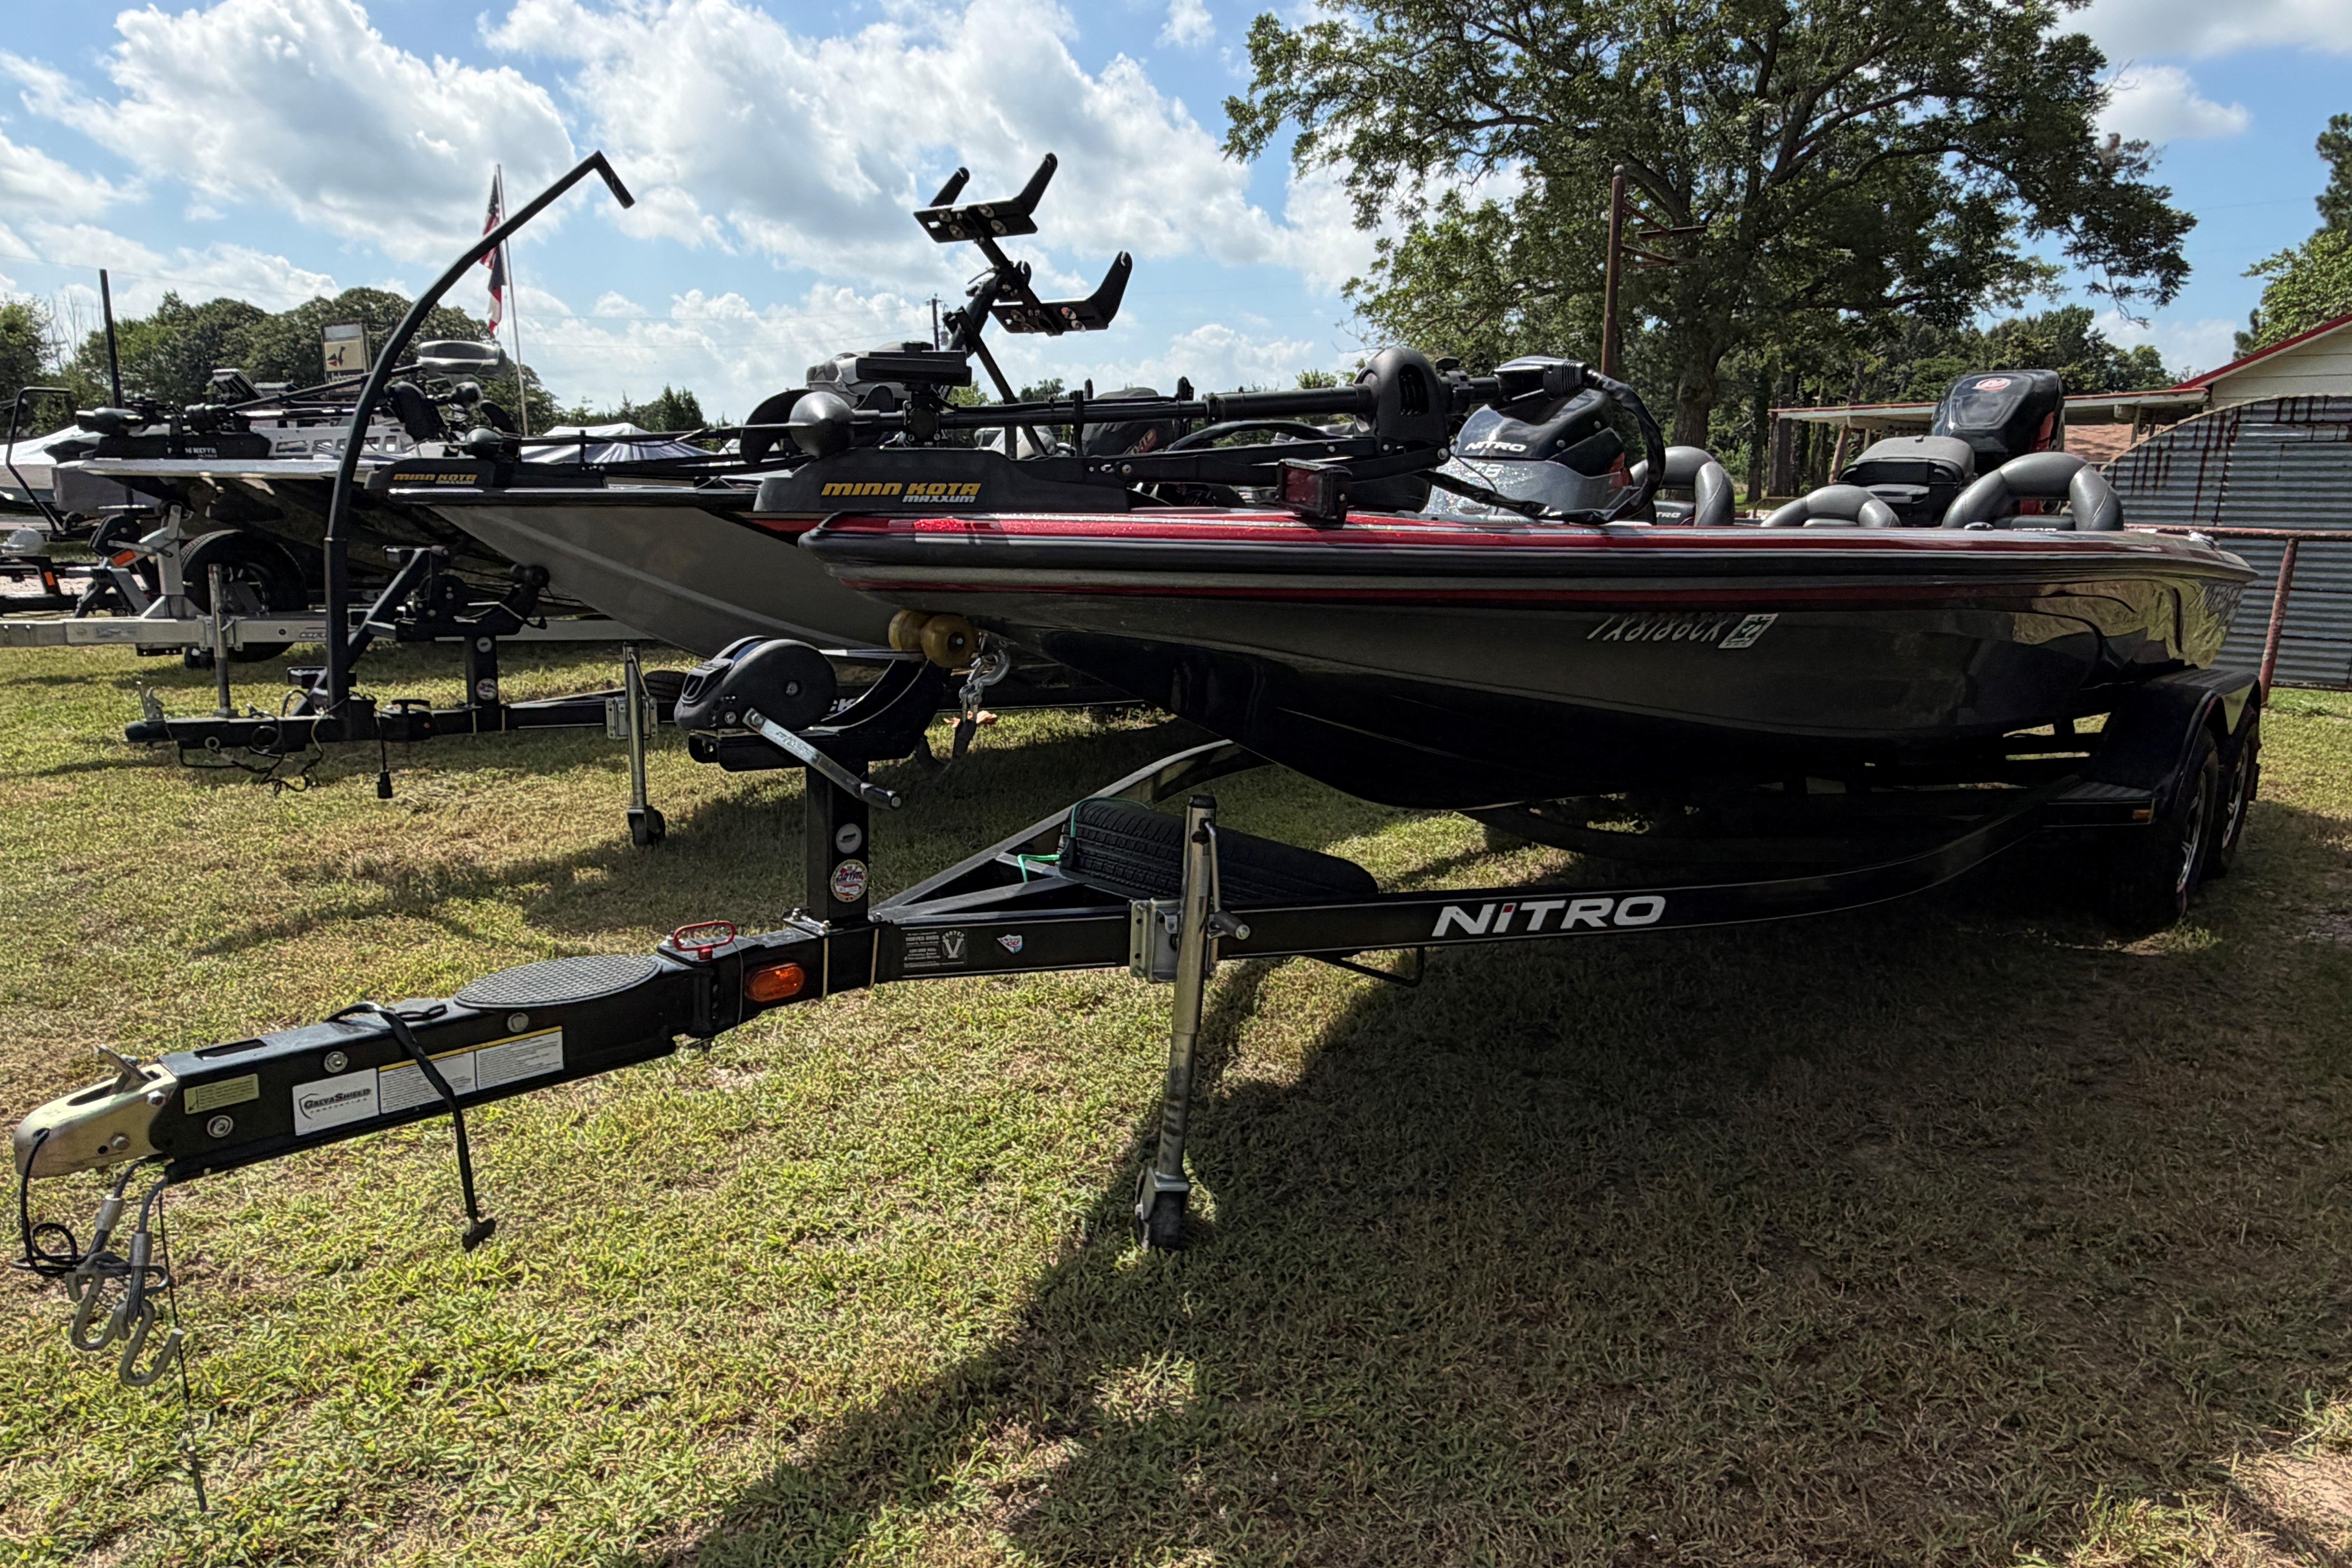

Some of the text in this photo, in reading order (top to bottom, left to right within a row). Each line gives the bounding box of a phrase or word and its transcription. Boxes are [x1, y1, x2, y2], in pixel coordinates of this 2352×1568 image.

[1465, 441, 1527, 452] NITRO
[821, 483, 982, 496] MINN KOTA
[902, 495, 976, 503] MAXXUM
[1431, 895, 1666, 937] NITRO
